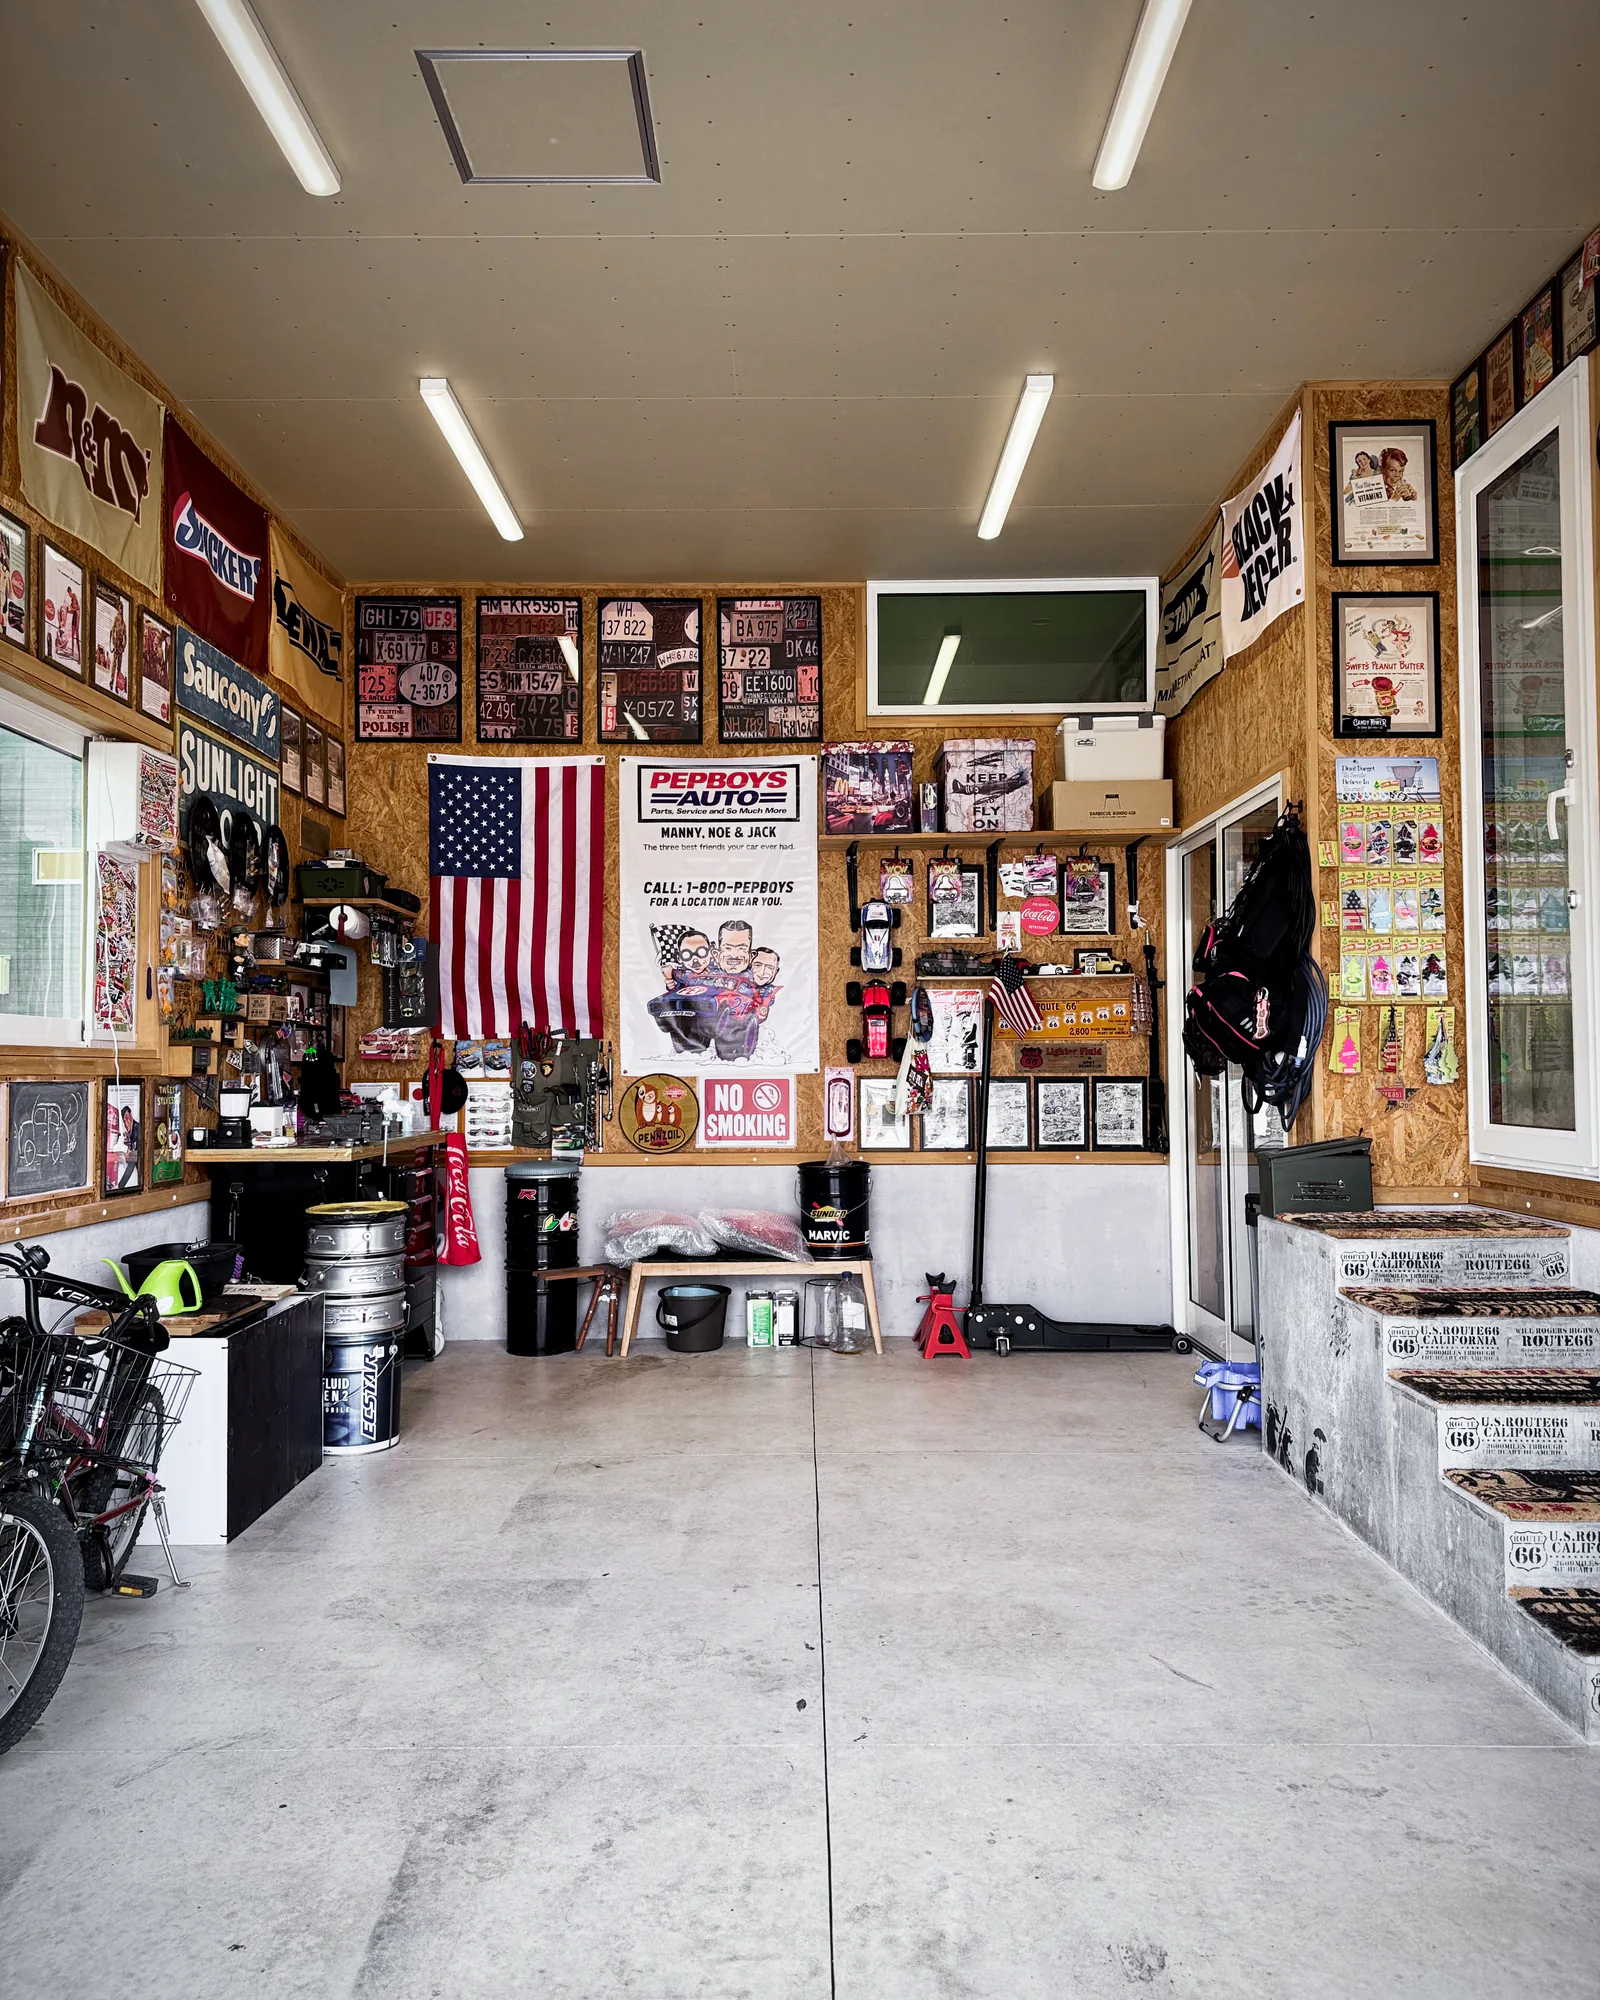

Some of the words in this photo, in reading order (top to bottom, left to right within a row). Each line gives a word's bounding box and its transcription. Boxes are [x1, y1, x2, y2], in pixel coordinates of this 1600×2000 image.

[1358, 492, 1383, 502] VITAMINS
[737, 620, 754, 637] BA
[758, 621, 778, 637] 975
[1400, 661, 1424, 669] BUTTER
[420, 665, 439, 681] 407
[183, 641, 260, 737] Saucony
[684, 710, 697, 721] 34
[362, 722, 409, 732] POLISH
[181, 729, 277, 831] SUNLIGHT
[650, 771, 787, 789] PEPBOYS
[966, 773, 1008, 783] KEEP
[677, 791, 759, 806] AUTO
[973, 806, 1001, 816] FLY
[972, 819, 1000, 829] ON
[661, 827, 705, 839] MANNY,
[708, 827, 731, 838] NOE
[734, 827, 744, 838] &
[747, 826, 777, 838] JACK
[885, 865, 908, 874] WOW
[934, 865, 958, 874] WOW
[1071, 862, 1095, 872] WOW
[643, 882, 682, 894] CALL:
[686, 881, 794, 893] 1-800-PEPBOYS
[650, 898, 669, 907] FOR
[672, 898, 678, 907] A
[681, 898, 729, 907] LOCATION
[732, 898, 758, 906] NEAR
[761, 898, 783, 906] YOU.
[1086, 966, 1096, 974] 40
[1069, 1027, 1089, 1036] 2,600
[159, 1085, 178, 1094] TWEETY
[715, 1084, 743, 1112] NO
[707, 1114, 786, 1137] SMOKING
[638, 1130, 681, 1144] PENNZOIL
[809, 1229, 850, 1241] MARVIC
[1344, 1263, 1365, 1276] 66
[1372, 1260, 1441, 1269] CALIFORNIA
[1546, 1262, 1565, 1277] 66
[54, 1286, 114, 1310] KENT
[1392, 1339, 1415, 1354] 66
[1422, 1336, 1497, 1346] CALIFORNIA
[362, 1353, 377, 1440] ECSTAR
[1483, 1427, 1565, 1438] CALIFORNIA
[1450, 1432, 1475, 1447] 66
[1515, 1547, 1541, 1564] 66
